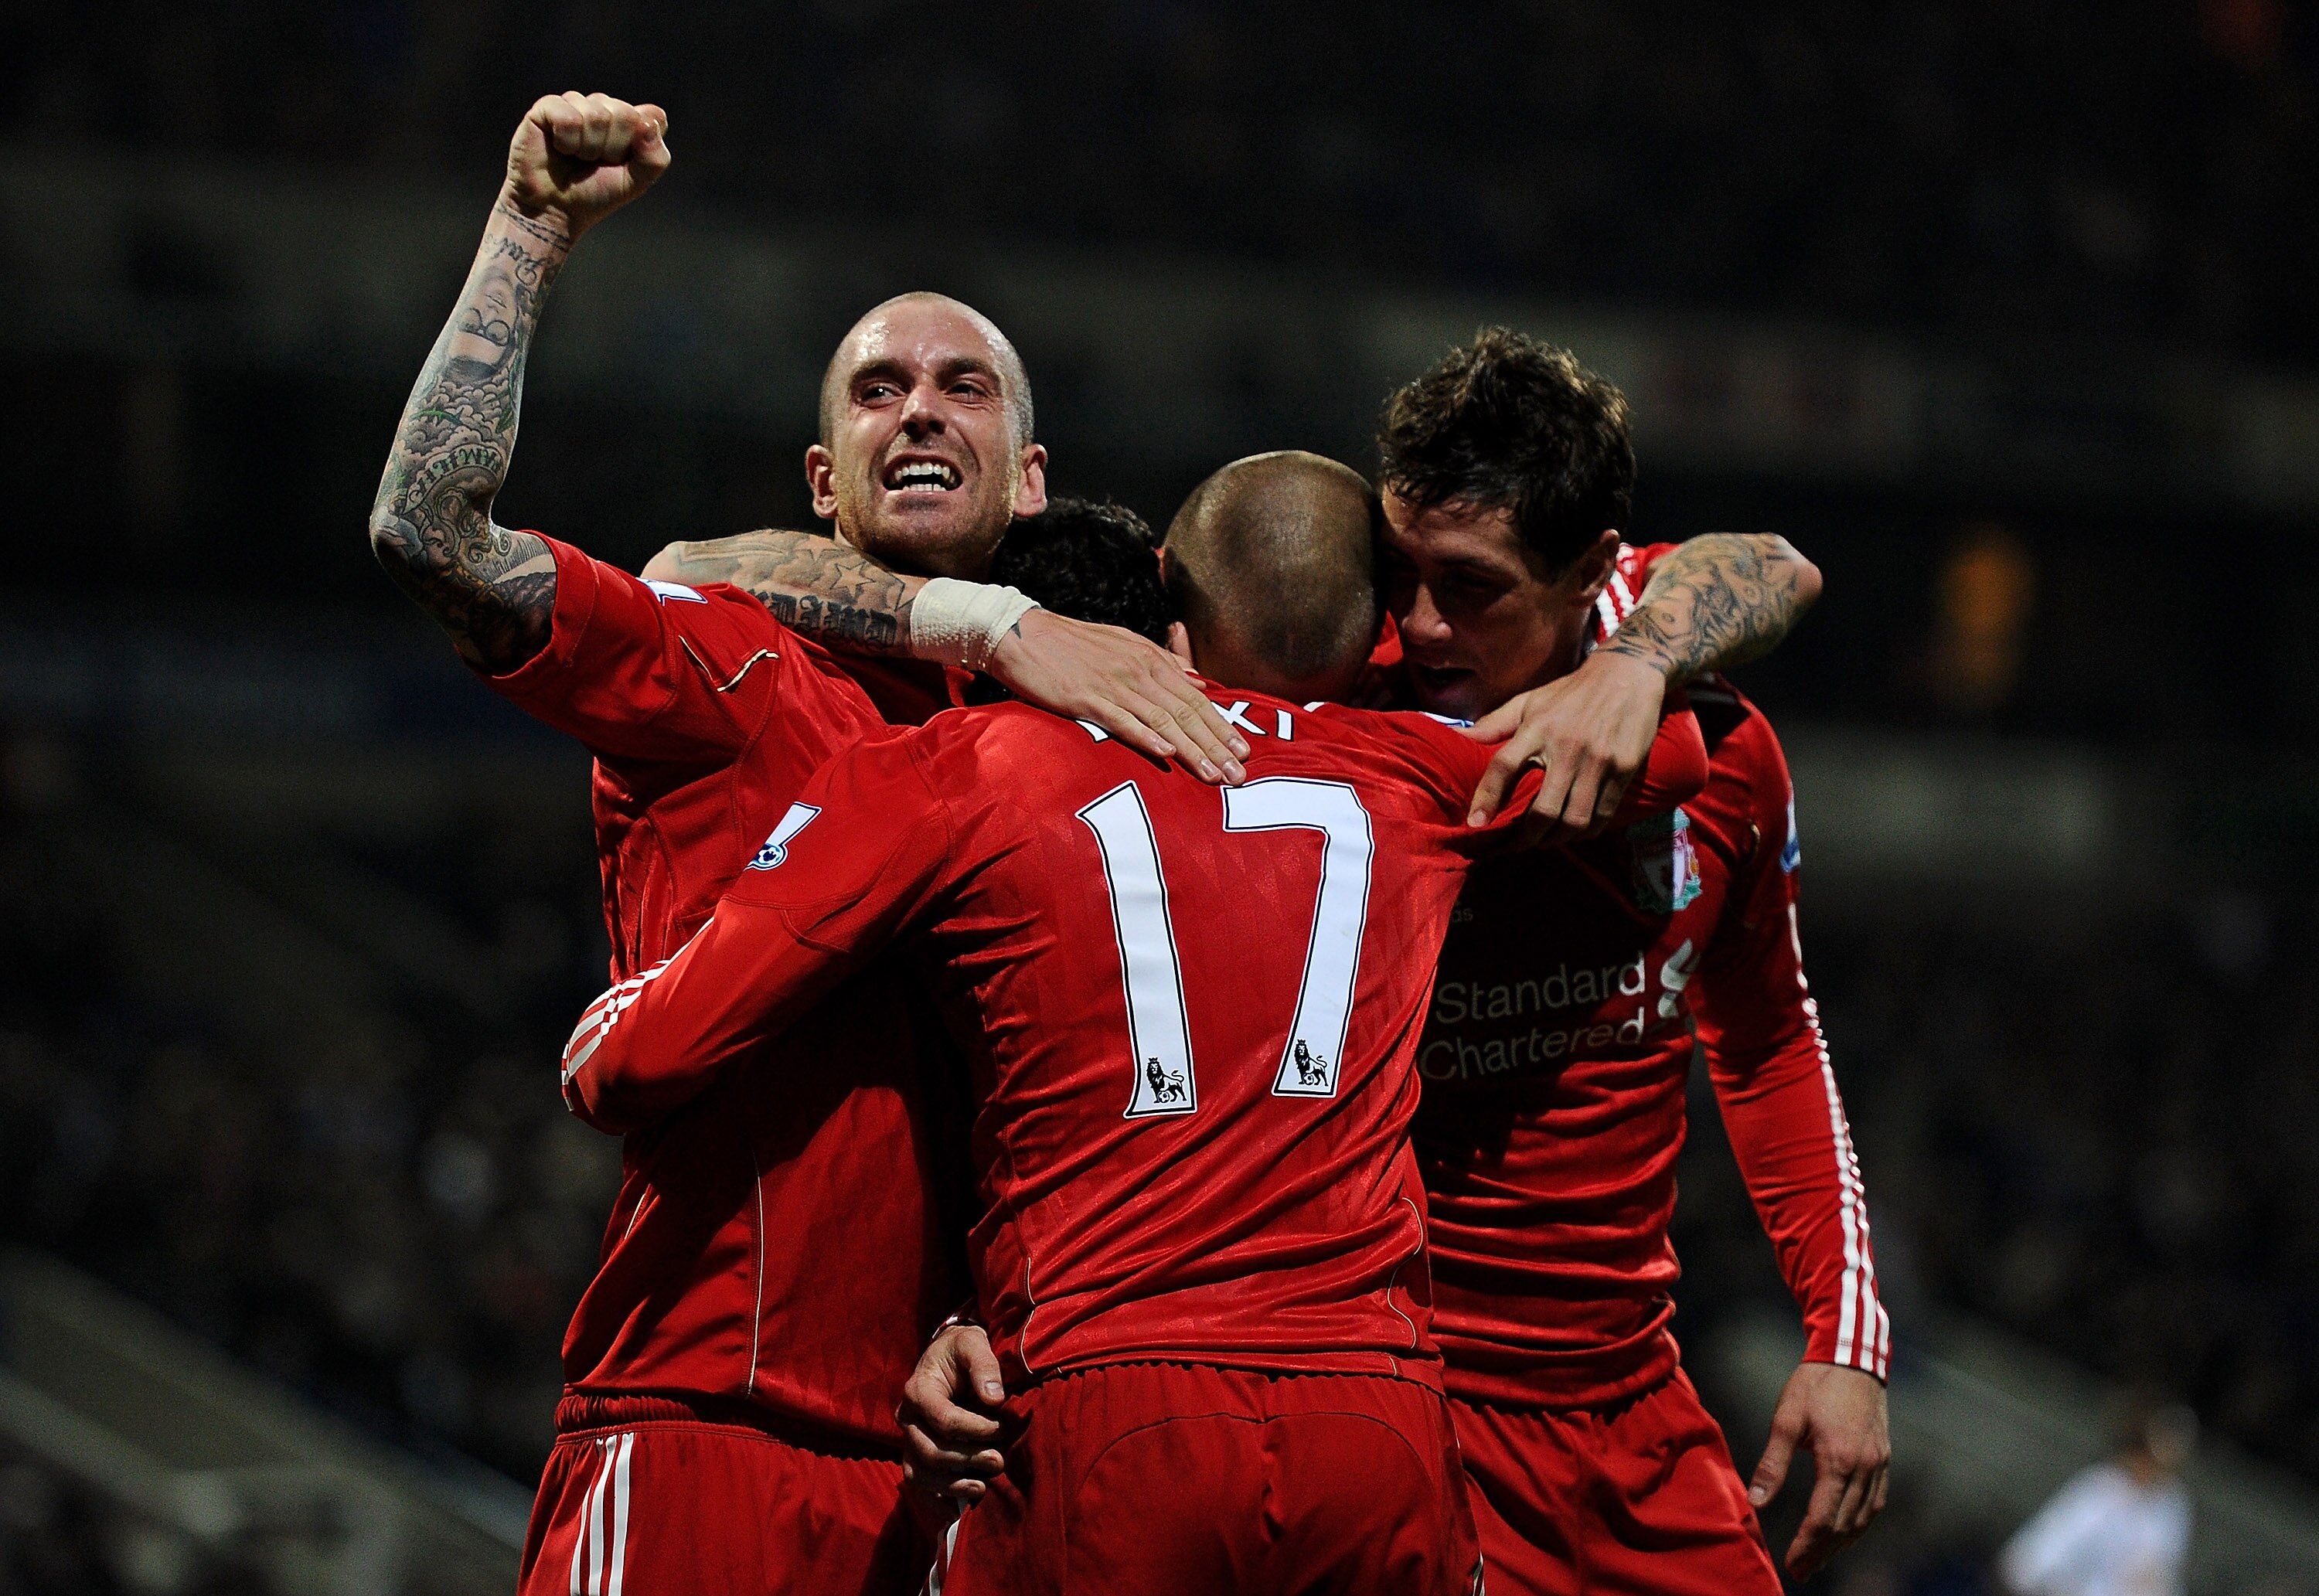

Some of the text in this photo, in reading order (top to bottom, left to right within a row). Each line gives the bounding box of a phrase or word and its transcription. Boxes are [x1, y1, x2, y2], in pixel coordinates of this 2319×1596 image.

[1074, 777, 1375, 1119] 17
[1434, 948, 1646, 1025] Standard
[1419, 1006, 1646, 1081] Chartered
